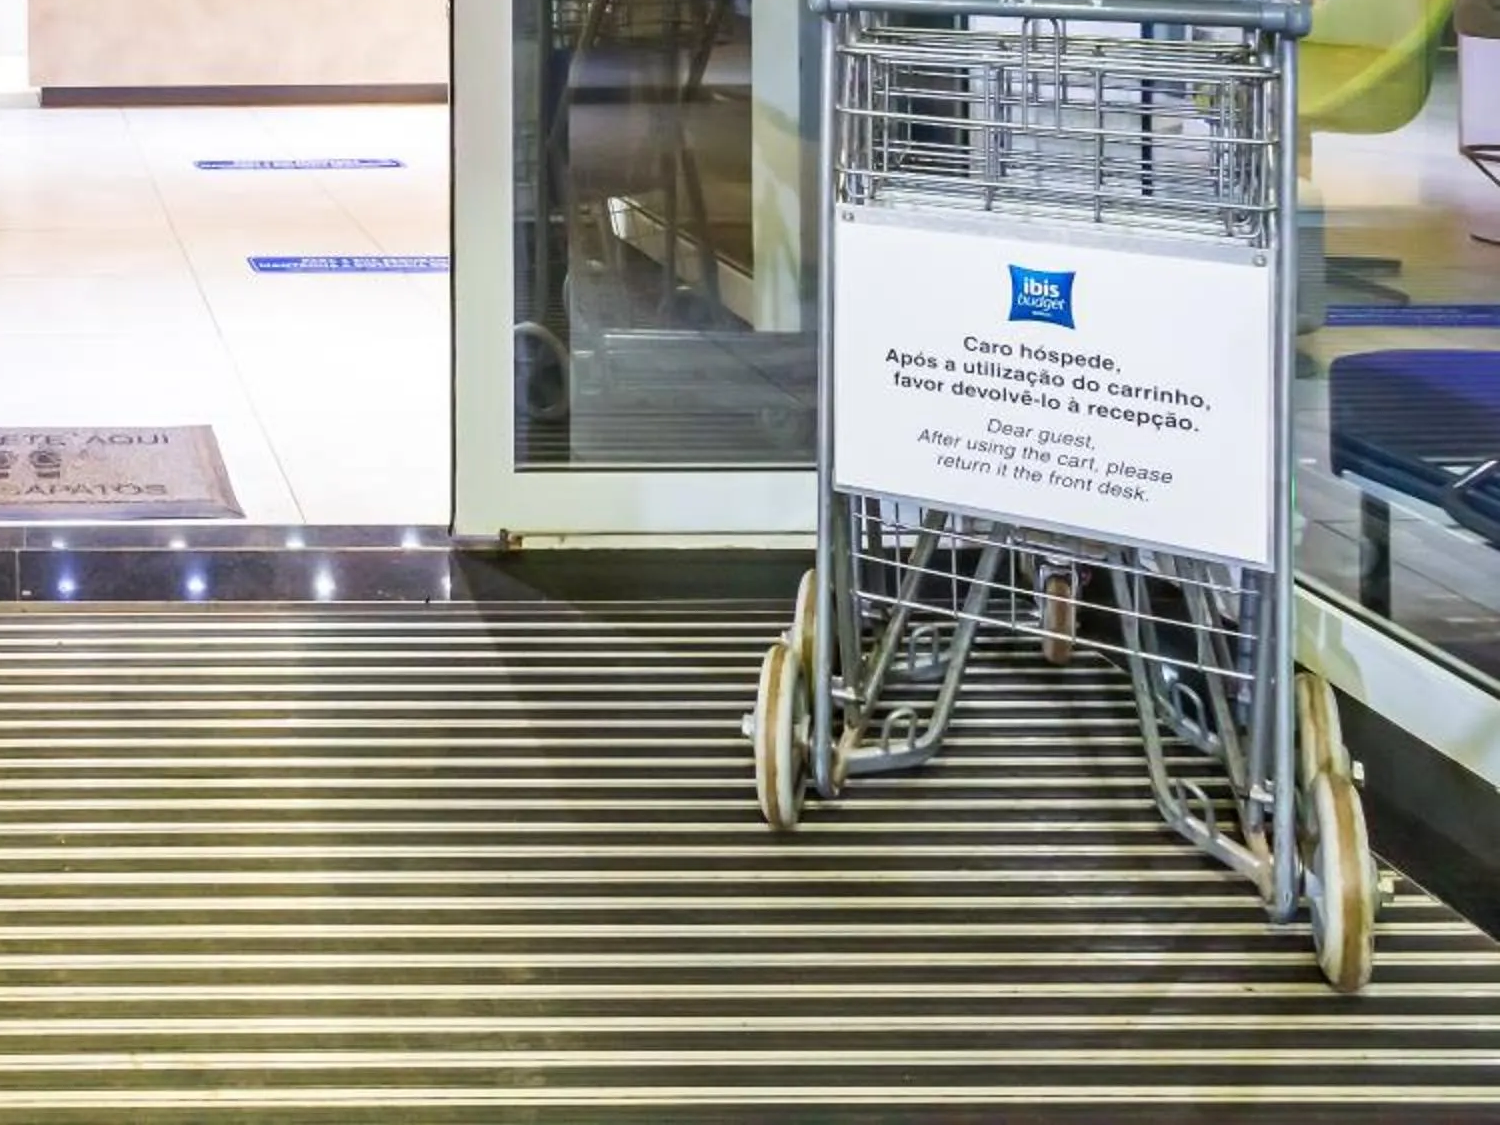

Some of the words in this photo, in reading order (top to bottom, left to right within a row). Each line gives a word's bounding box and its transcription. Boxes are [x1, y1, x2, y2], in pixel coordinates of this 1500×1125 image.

[1017, 292, 1066, 311] budget
[1023, 276, 1060, 298] ibis
[963, 336, 1013, 358] Caro
[1020, 343, 1122, 373] hóspede,
[886, 348, 937, 371] Após
[945, 360, 956, 372] a
[963, 361, 1065, 388] utilização
[1072, 374, 1101, 393] do
[1108, 381, 1212, 412] carrinho,
[894, 373, 944, 394] favor
[952, 380, 1061, 412] devolvê-lo
[1068, 396, 1080, 414] à
[1088, 403, 1200, 433] recepção.
[86, 431, 170, 446] AQUI
[987, 418, 1033, 439] Dear
[1038, 427, 1097, 452] guest,
[918, 428, 961, 449] After
[967, 436, 1016, 461] using
[1023, 444, 1051, 464] the
[1057, 453, 1100, 474] cart,
[1106, 459, 1174, 485] please
[937, 455, 991, 476] return
[996, 460, 1008, 478] it
[1014, 464, 1043, 484] the
[1049, 470, 1093, 492] front
[1098, 479, 1150, 503] desk.
